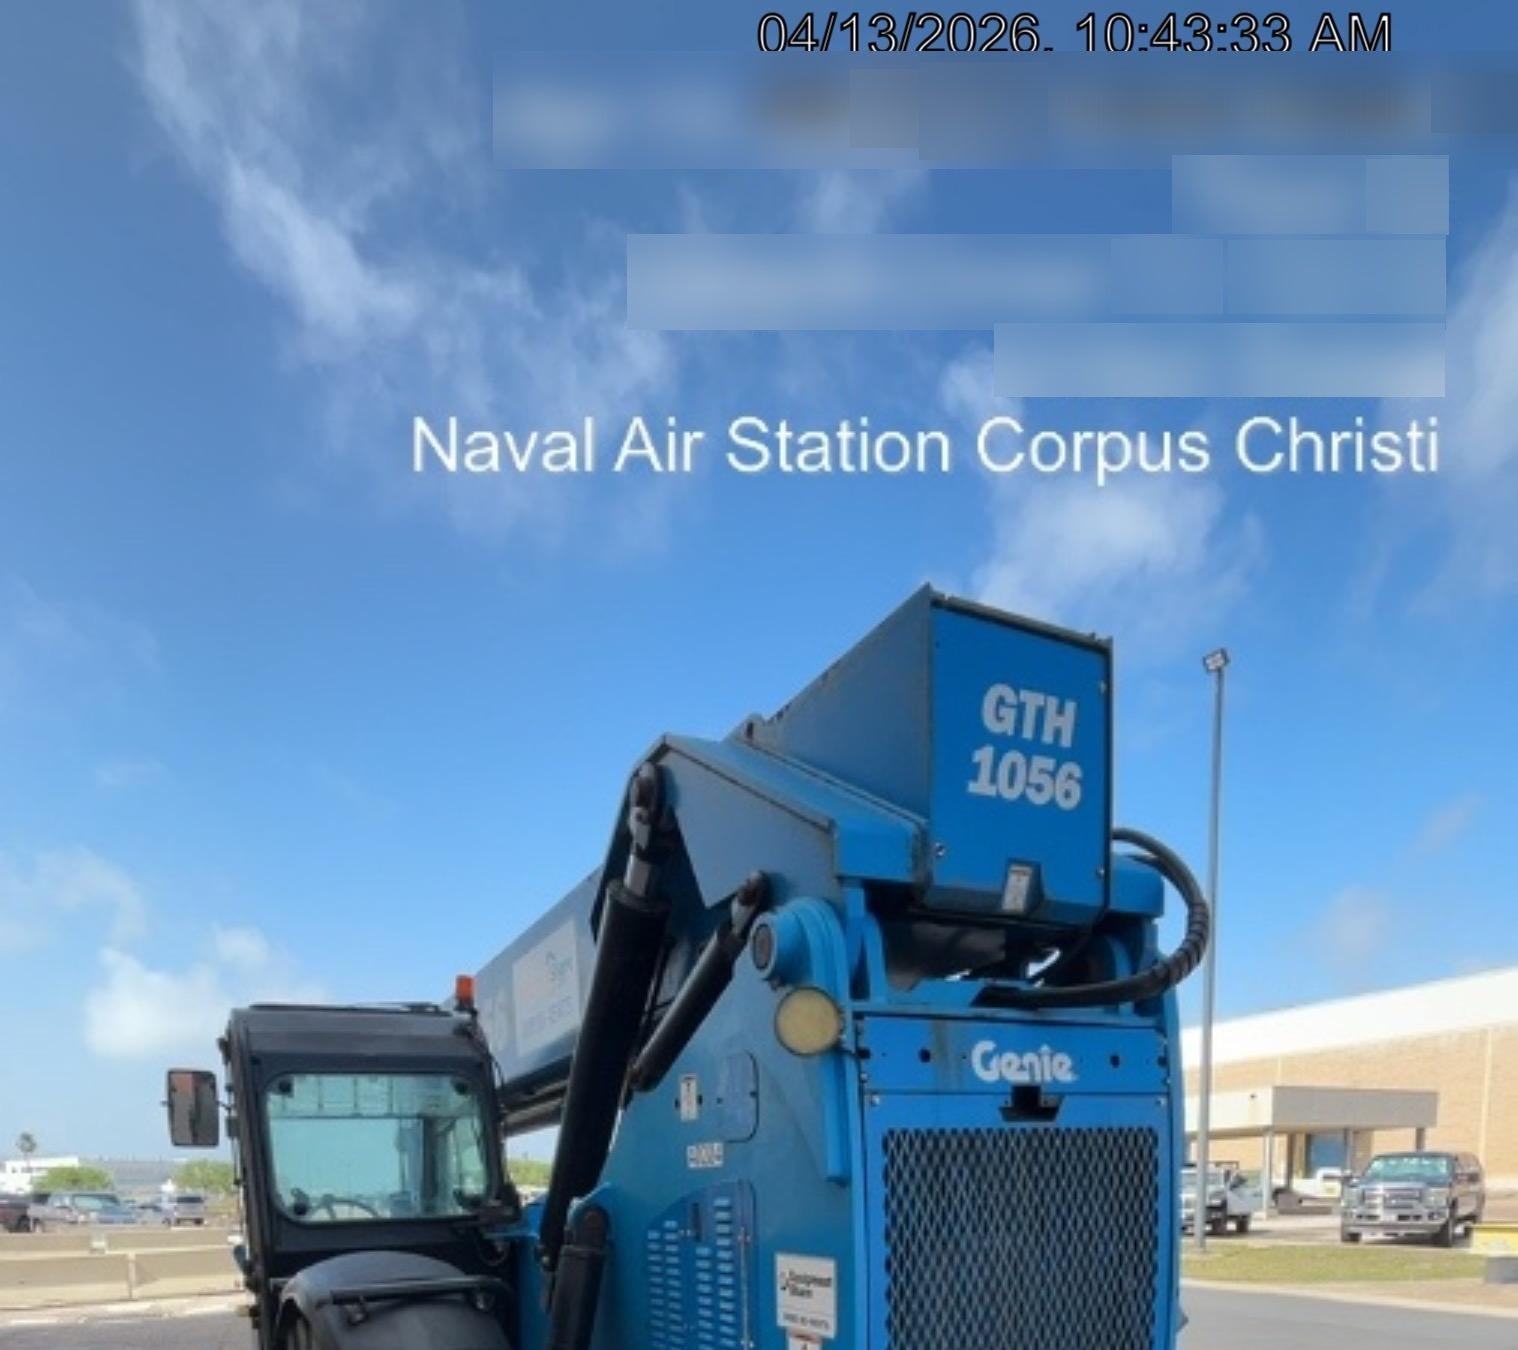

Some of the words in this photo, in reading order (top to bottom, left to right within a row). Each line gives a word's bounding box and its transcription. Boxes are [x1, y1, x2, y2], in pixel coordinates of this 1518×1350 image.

[982, 683, 1077, 748] GTH
[967, 745, 1083, 811] 1056
[971, 1040, 1077, 1083] Genie
